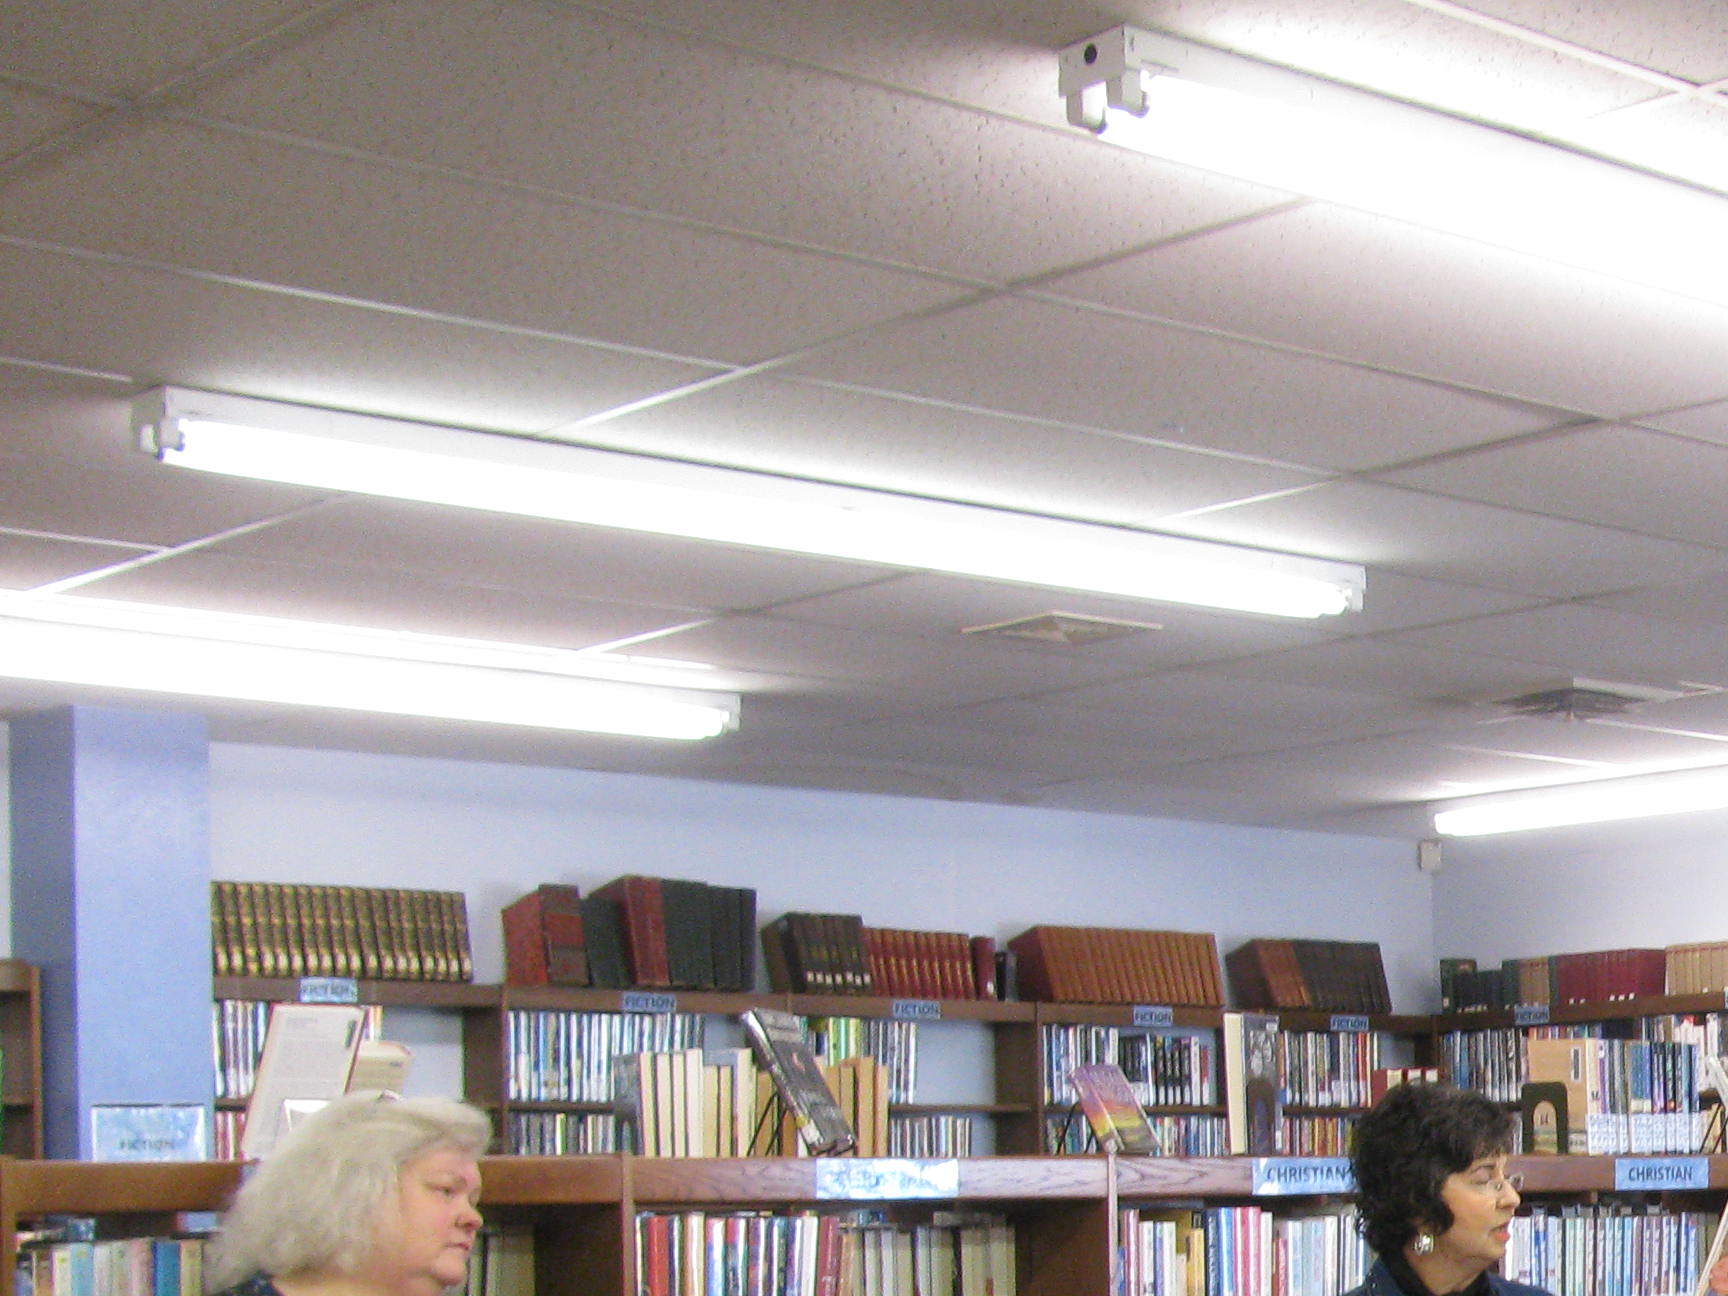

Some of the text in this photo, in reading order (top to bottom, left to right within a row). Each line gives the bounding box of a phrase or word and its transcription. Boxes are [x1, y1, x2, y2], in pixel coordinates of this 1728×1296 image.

[625, 994, 675, 1009] FICTION
[895, 1002, 939, 1015] FICTION
[1135, 1011, 1172, 1023] FICTION
[1332, 1016, 1367, 1029] FICTION
[1266, 1164, 1346, 1184] CHRISTIAN
[1628, 1166, 1693, 1182] CHRISTIAN
